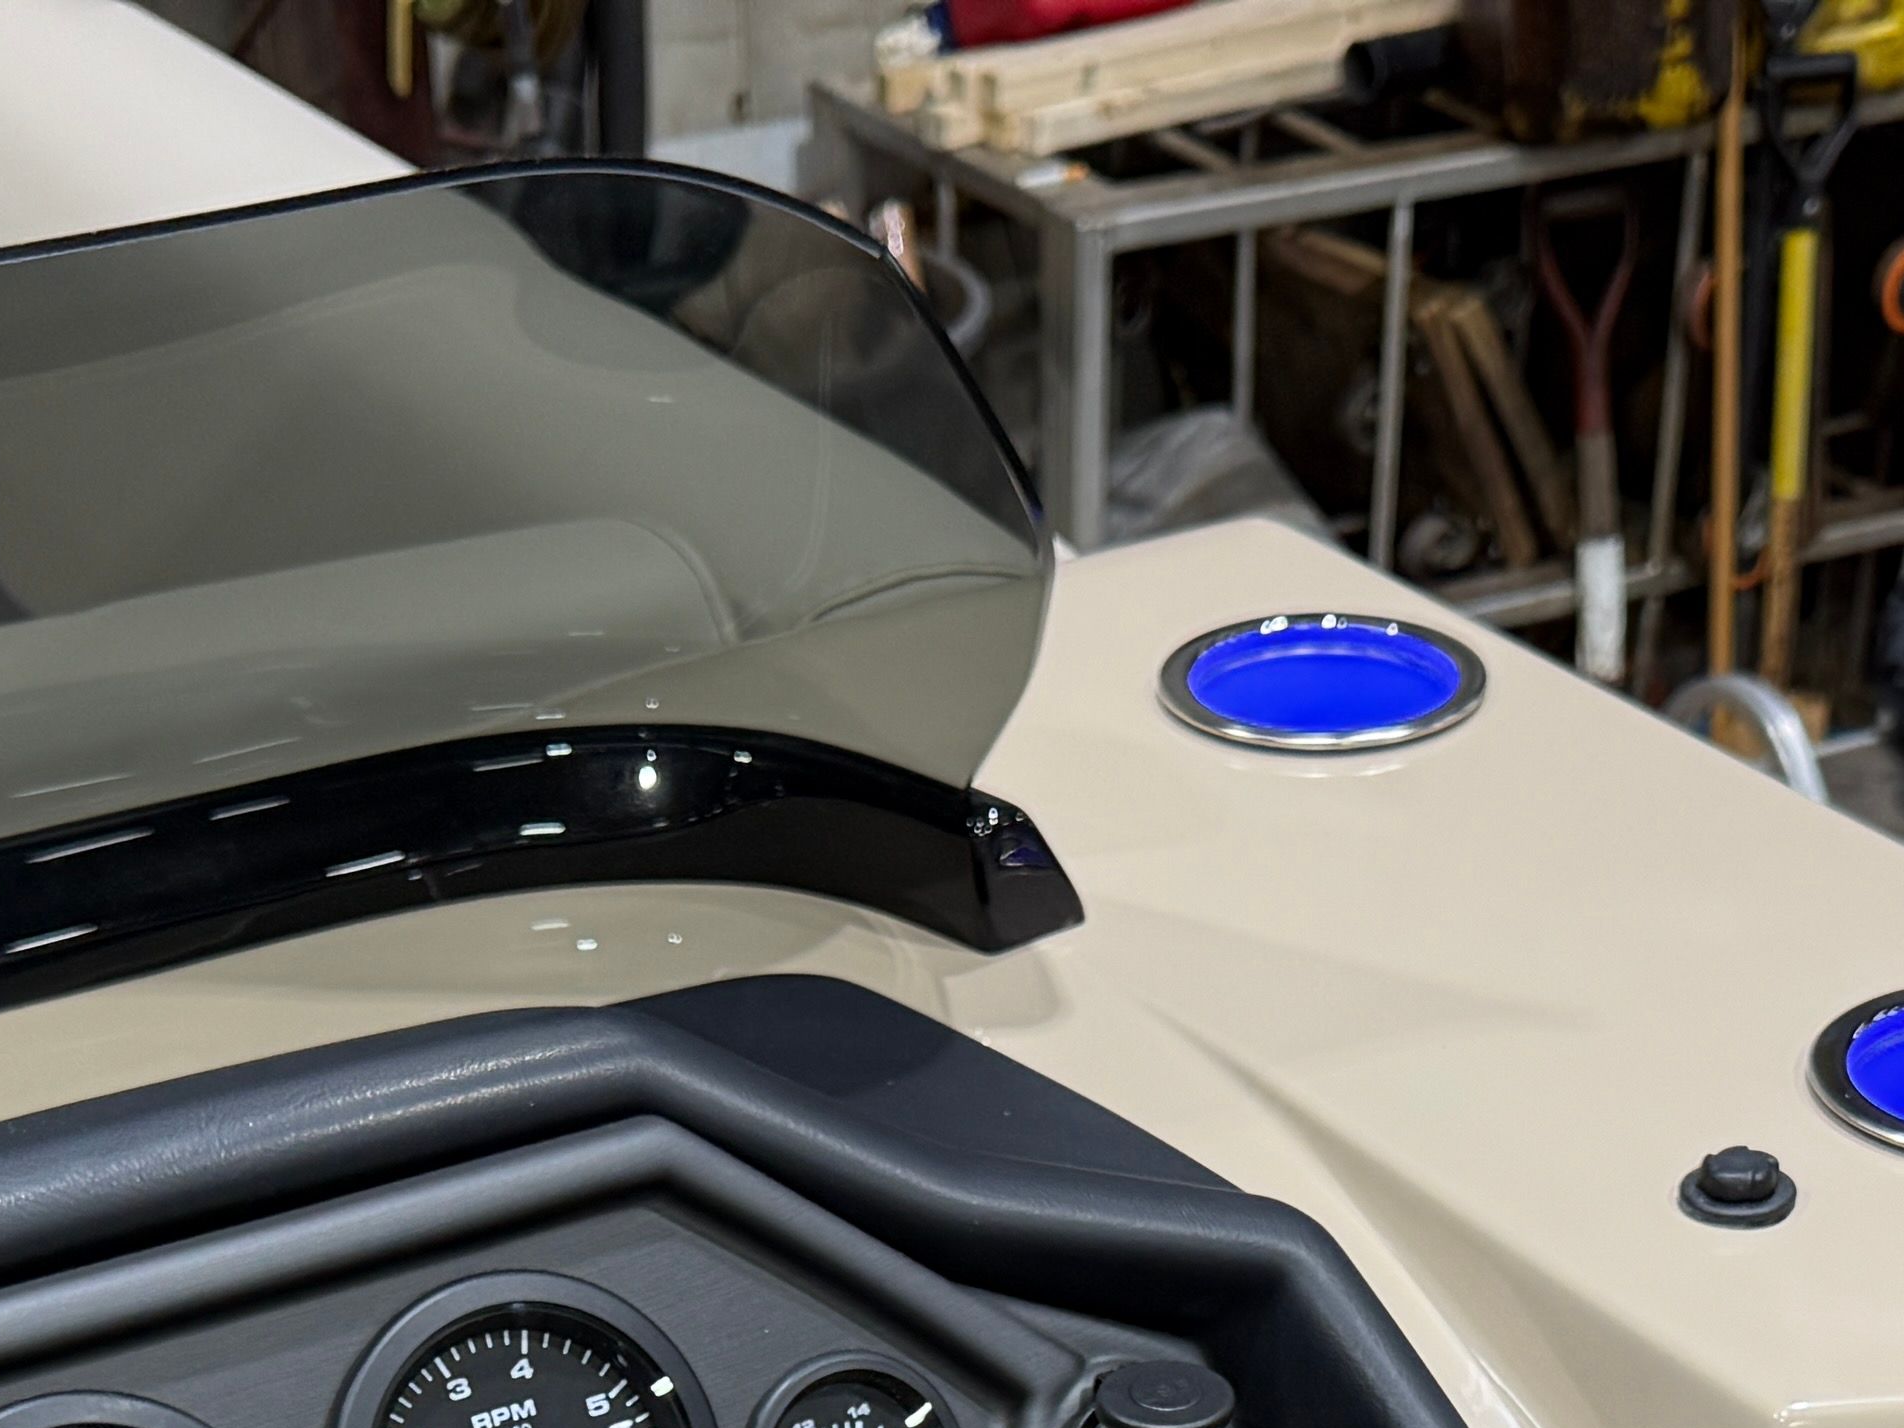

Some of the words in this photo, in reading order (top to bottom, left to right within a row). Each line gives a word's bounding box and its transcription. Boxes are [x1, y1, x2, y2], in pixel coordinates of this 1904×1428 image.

[510, 1357, 534, 1380] 4
[446, 1377, 472, 1401] 3
[585, 1393, 610, 1417] 5
[847, 1402, 871, 1419] 14
